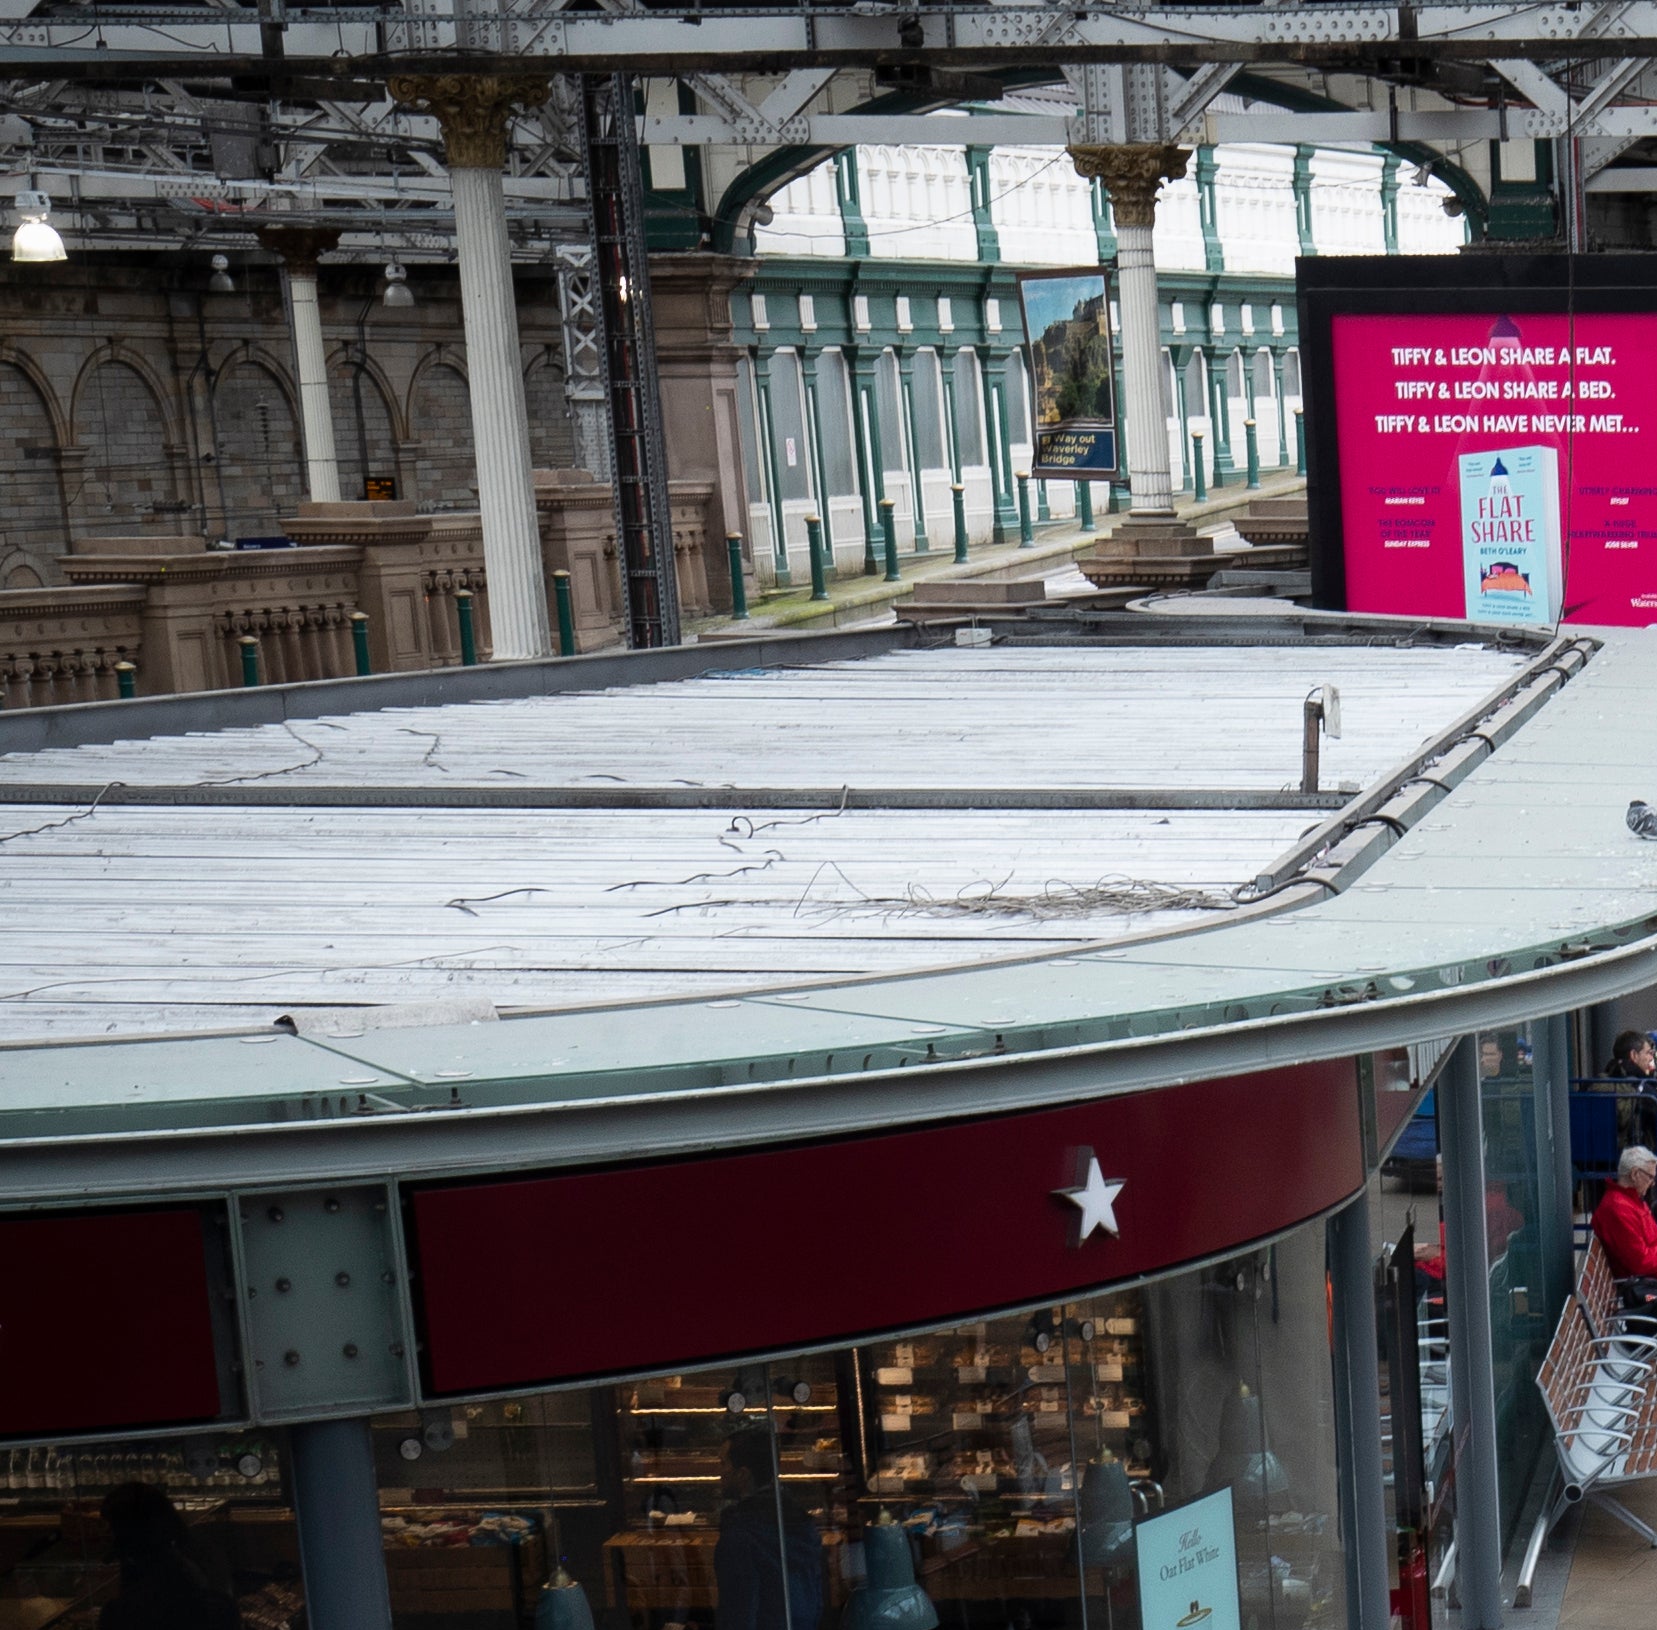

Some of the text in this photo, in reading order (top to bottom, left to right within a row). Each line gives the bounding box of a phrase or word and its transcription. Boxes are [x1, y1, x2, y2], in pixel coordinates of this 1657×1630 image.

[1391, 348, 1616, 365] TIFFY & LEON SHARE A FLAT.
[1396, 382, 1616, 399] TIFFY & LEON SHARE A BED.
[1376, 415, 1639, 433] TIFFY & LEON HAVE NEVER MET...
[1055, 434, 1095, 444] Way out
[1043, 444, 1089, 455] Waverley
[1042, 456, 1075, 465] Bridge
[1493, 486, 1507, 494] THE
[1478, 495, 1525, 519] FLAT
[1471, 519, 1536, 544] SHARE
[1499, 547, 1527, 555] O'LEARY
